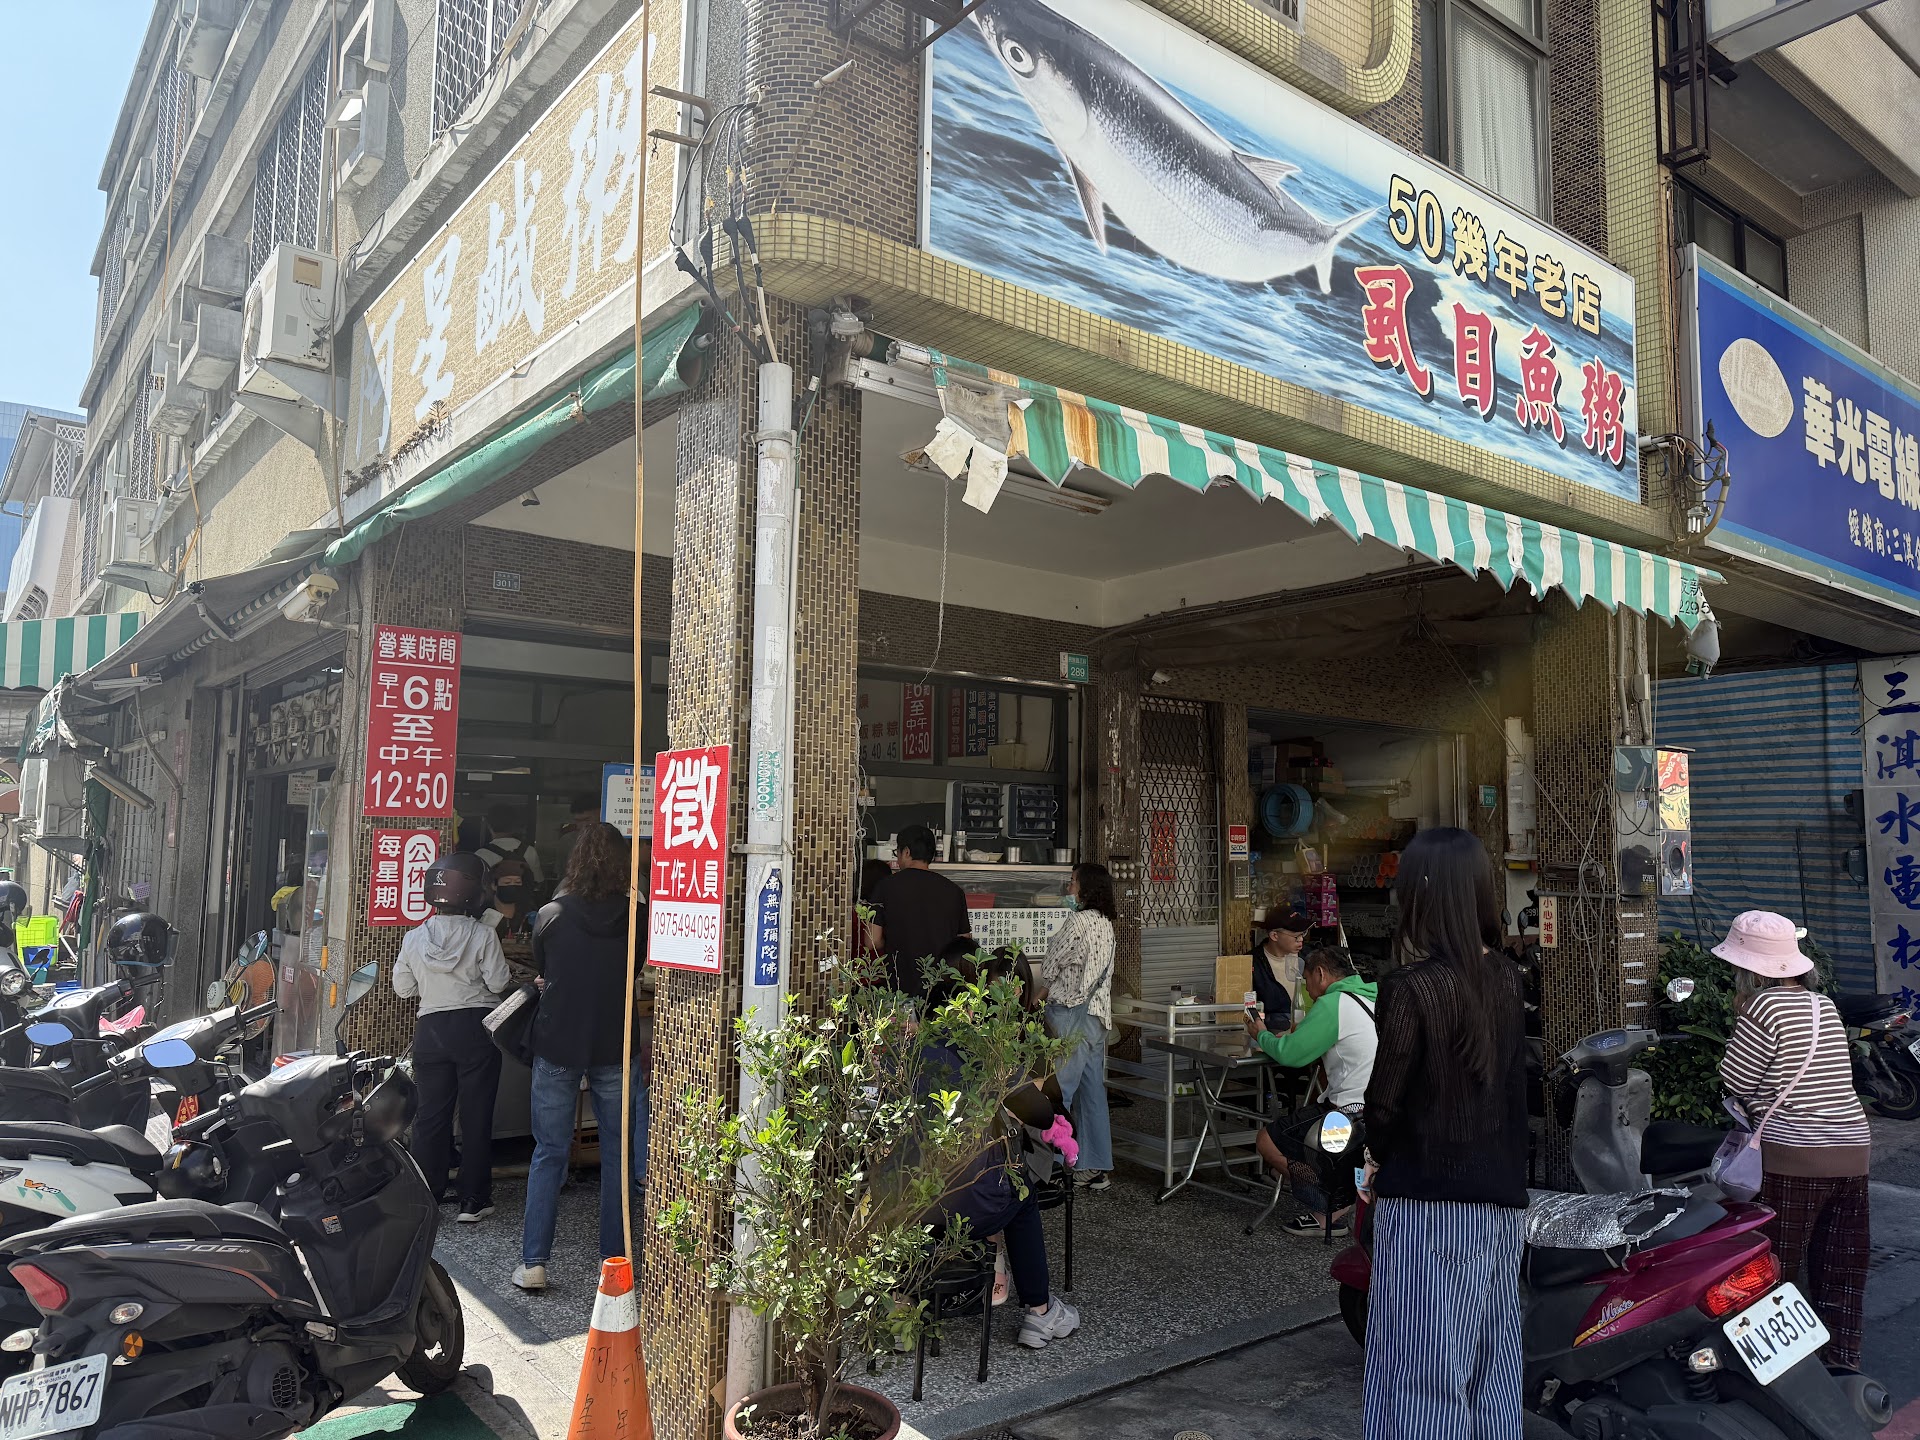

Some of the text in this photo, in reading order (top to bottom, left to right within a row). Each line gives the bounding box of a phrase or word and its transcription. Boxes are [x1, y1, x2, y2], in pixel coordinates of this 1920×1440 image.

[1387, 173, 1601, 335] 50幾年老店
[1353, 264, 1627, 472] 虱目魚粥
[378, 631, 456, 664] 營業時間
[1070, 666, 1085, 677] 289
[909, 699, 925, 717] 至
[390, 713, 435, 743] 至
[906, 717, 928, 731] 中午
[379, 744, 443, 767] 中午
[872, 743, 881, 759] 40
[886, 742, 897, 758] 45
[904, 731, 930, 755] 12:50
[371, 769, 448, 810] 12:50
[660, 755, 721, 850] 徵
[373, 834, 402, 921] 每星期一
[406, 842, 428, 913] 公休日
[654, 858, 719, 899] 工作人員
[653, 911, 717, 941] 0975494095
[760, 875, 781, 979] 南無阿彌陀佛
[1542, 898, 1554, 945] 小心地滑
[703, 945, 716, 963] 洽
[165, 1244, 242, 1253] JOG
